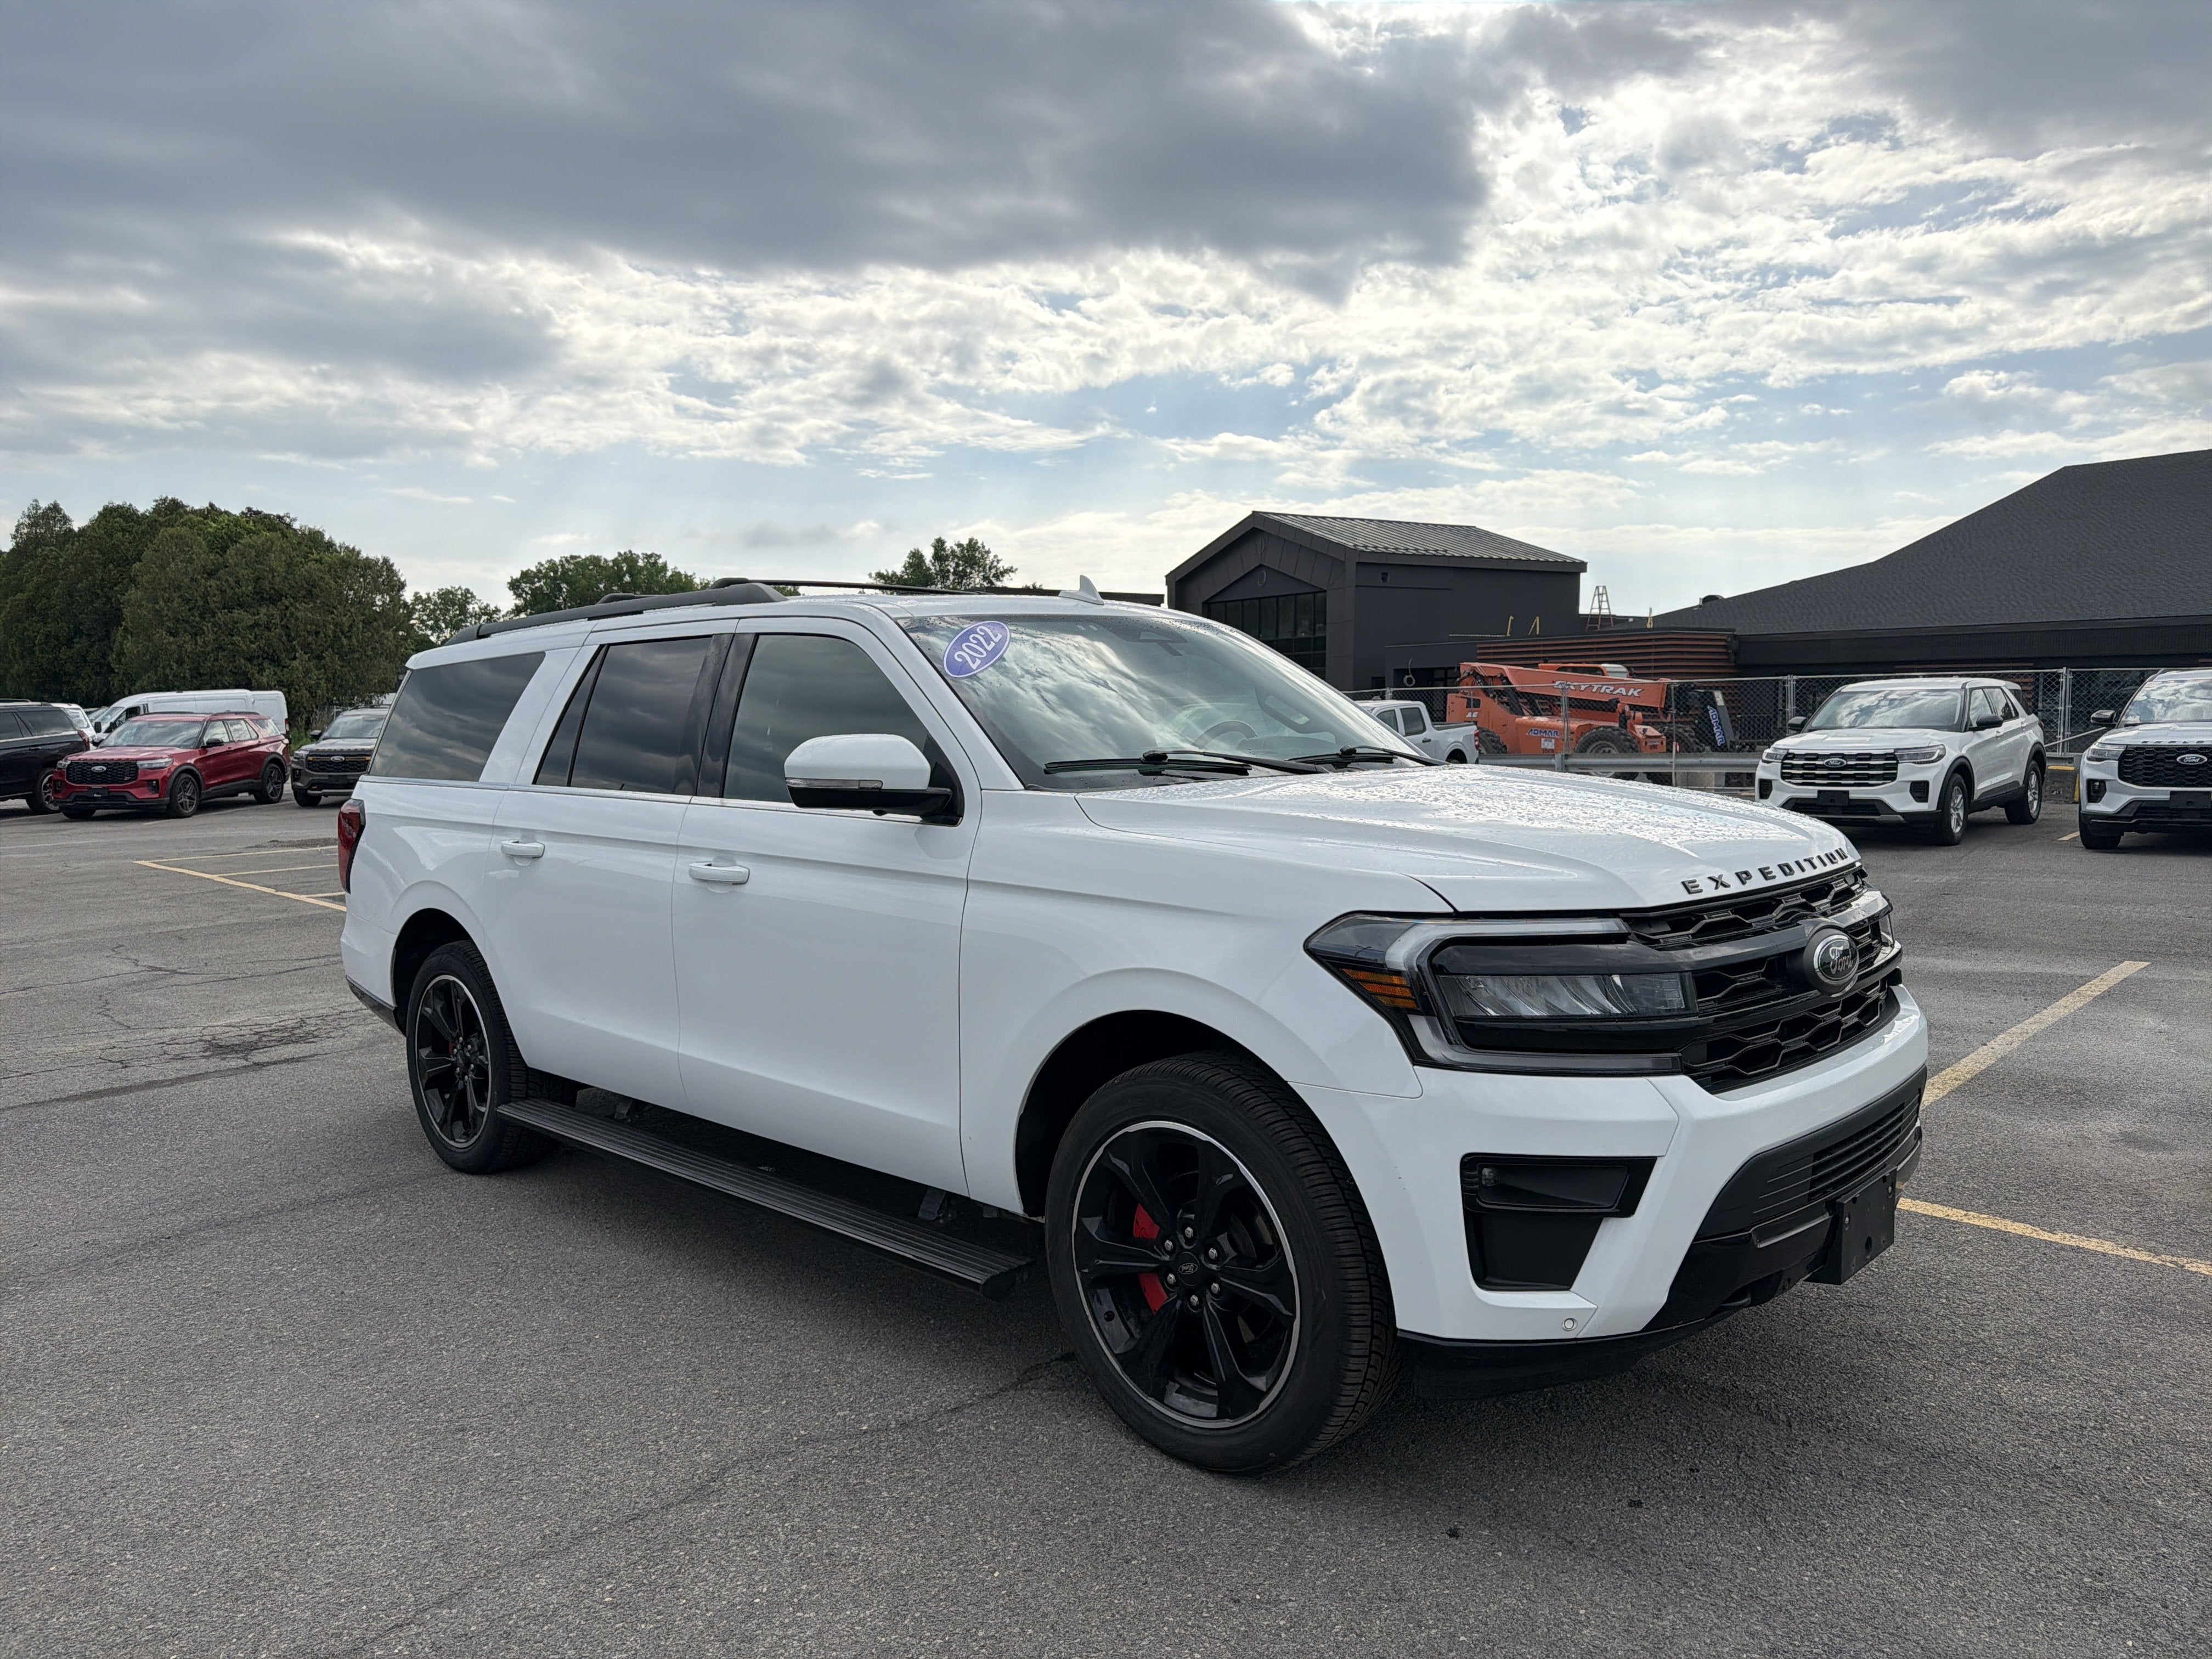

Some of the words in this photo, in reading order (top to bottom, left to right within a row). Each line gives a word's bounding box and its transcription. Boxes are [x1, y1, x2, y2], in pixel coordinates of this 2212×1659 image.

[954, 625, 1002, 670] 2022
[1526, 728, 1560, 737] ADMAR
[1707, 706, 1725, 747] ADMAR
[1680, 847, 1849, 895] EXPEDITION
[1830, 945, 1854, 975] Ford
